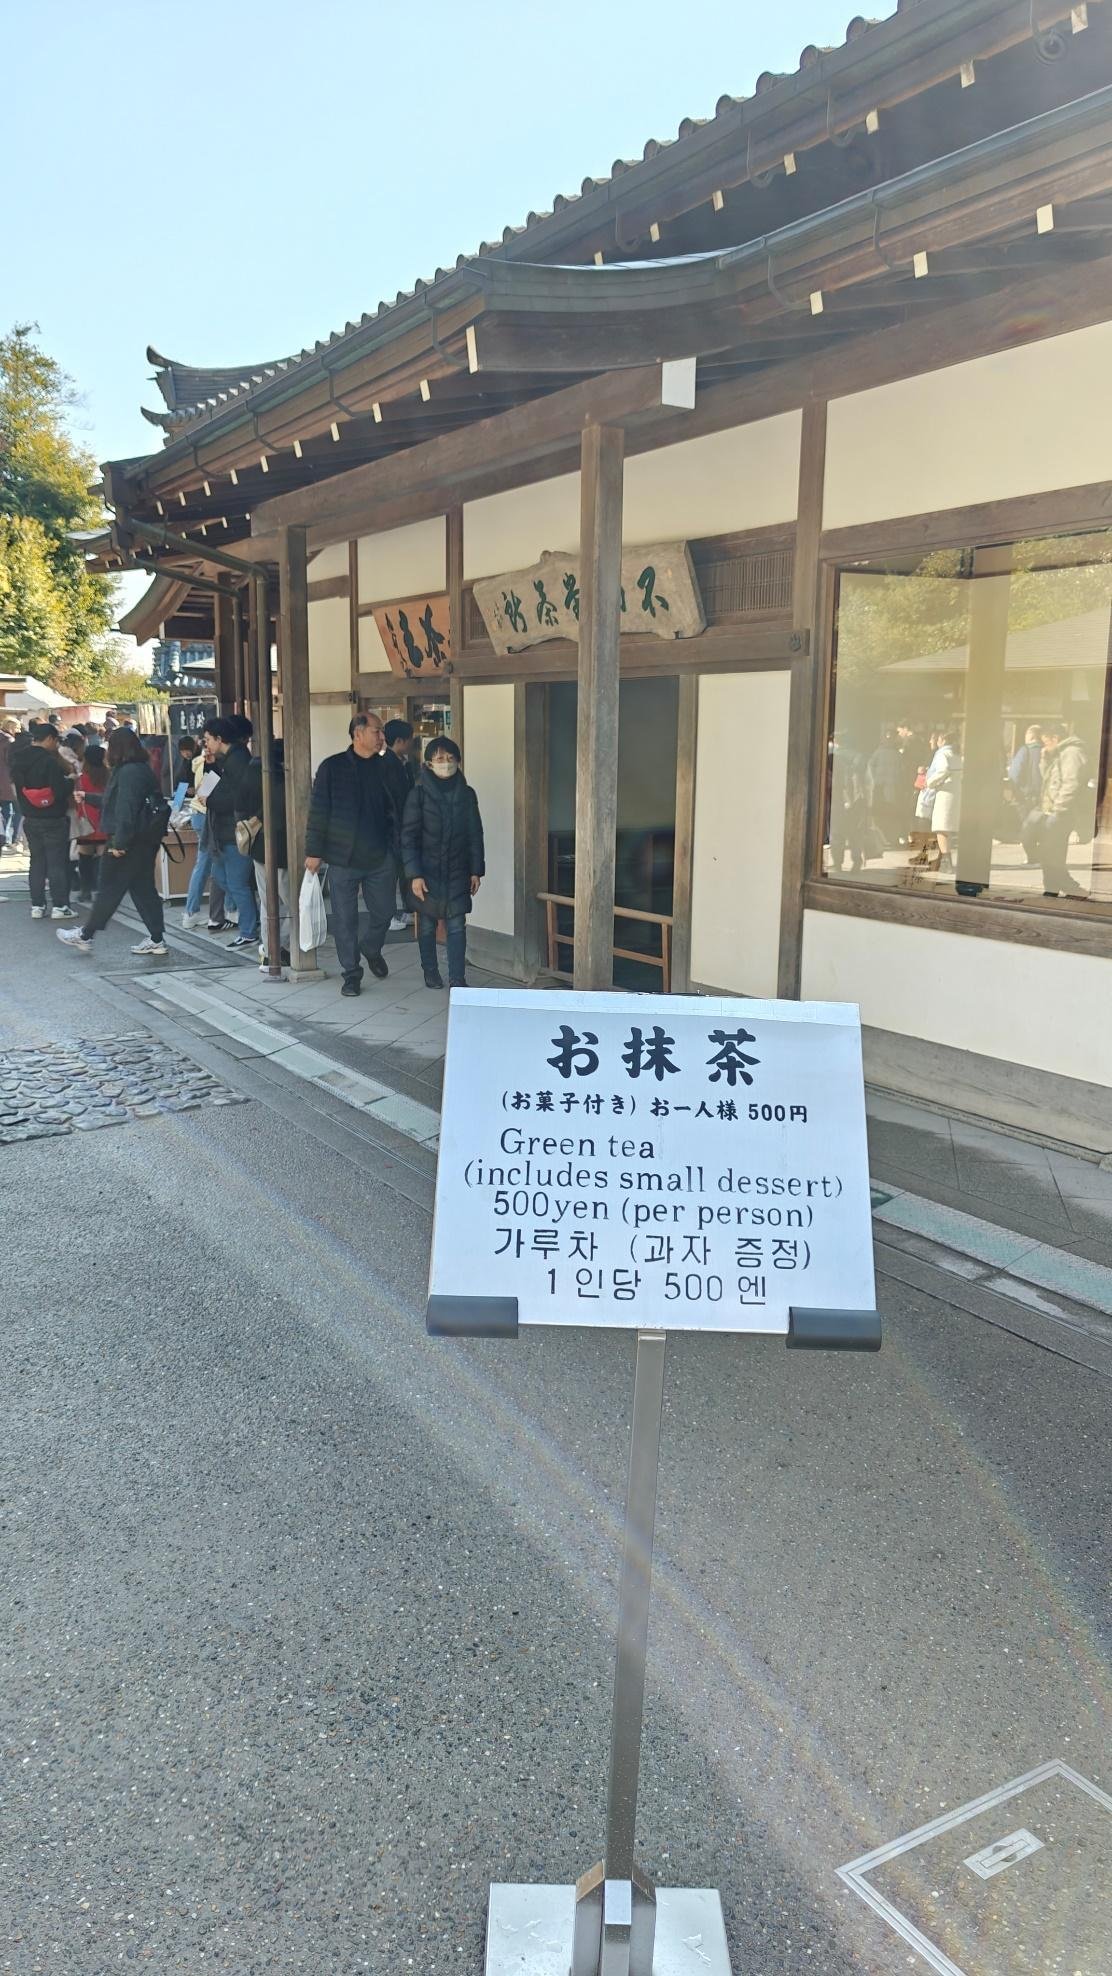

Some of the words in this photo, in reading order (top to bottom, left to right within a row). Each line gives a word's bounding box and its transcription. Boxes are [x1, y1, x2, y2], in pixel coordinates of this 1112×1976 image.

[547, 1025, 761, 1087] お抹茶
[649, 1097, 739, 1122] お一人様
[748, 1103, 808, 1123] 500円
[499, 1127, 597, 1158] Green
[607, 1135, 656, 1159] tea
[464, 1158, 609, 1190] (includes
[619, 1165, 705, 1194] small
[717, 1167, 844, 1199] dessert)
[493, 1189, 610, 1225] 500yen
[621, 1196, 687, 1229] (per
[696, 1204, 814, 1231] person)
[493, 1227, 599, 1262] 가루차
[629, 1233, 712, 1266] (과자
[735, 1235, 812, 1271] 증정)
